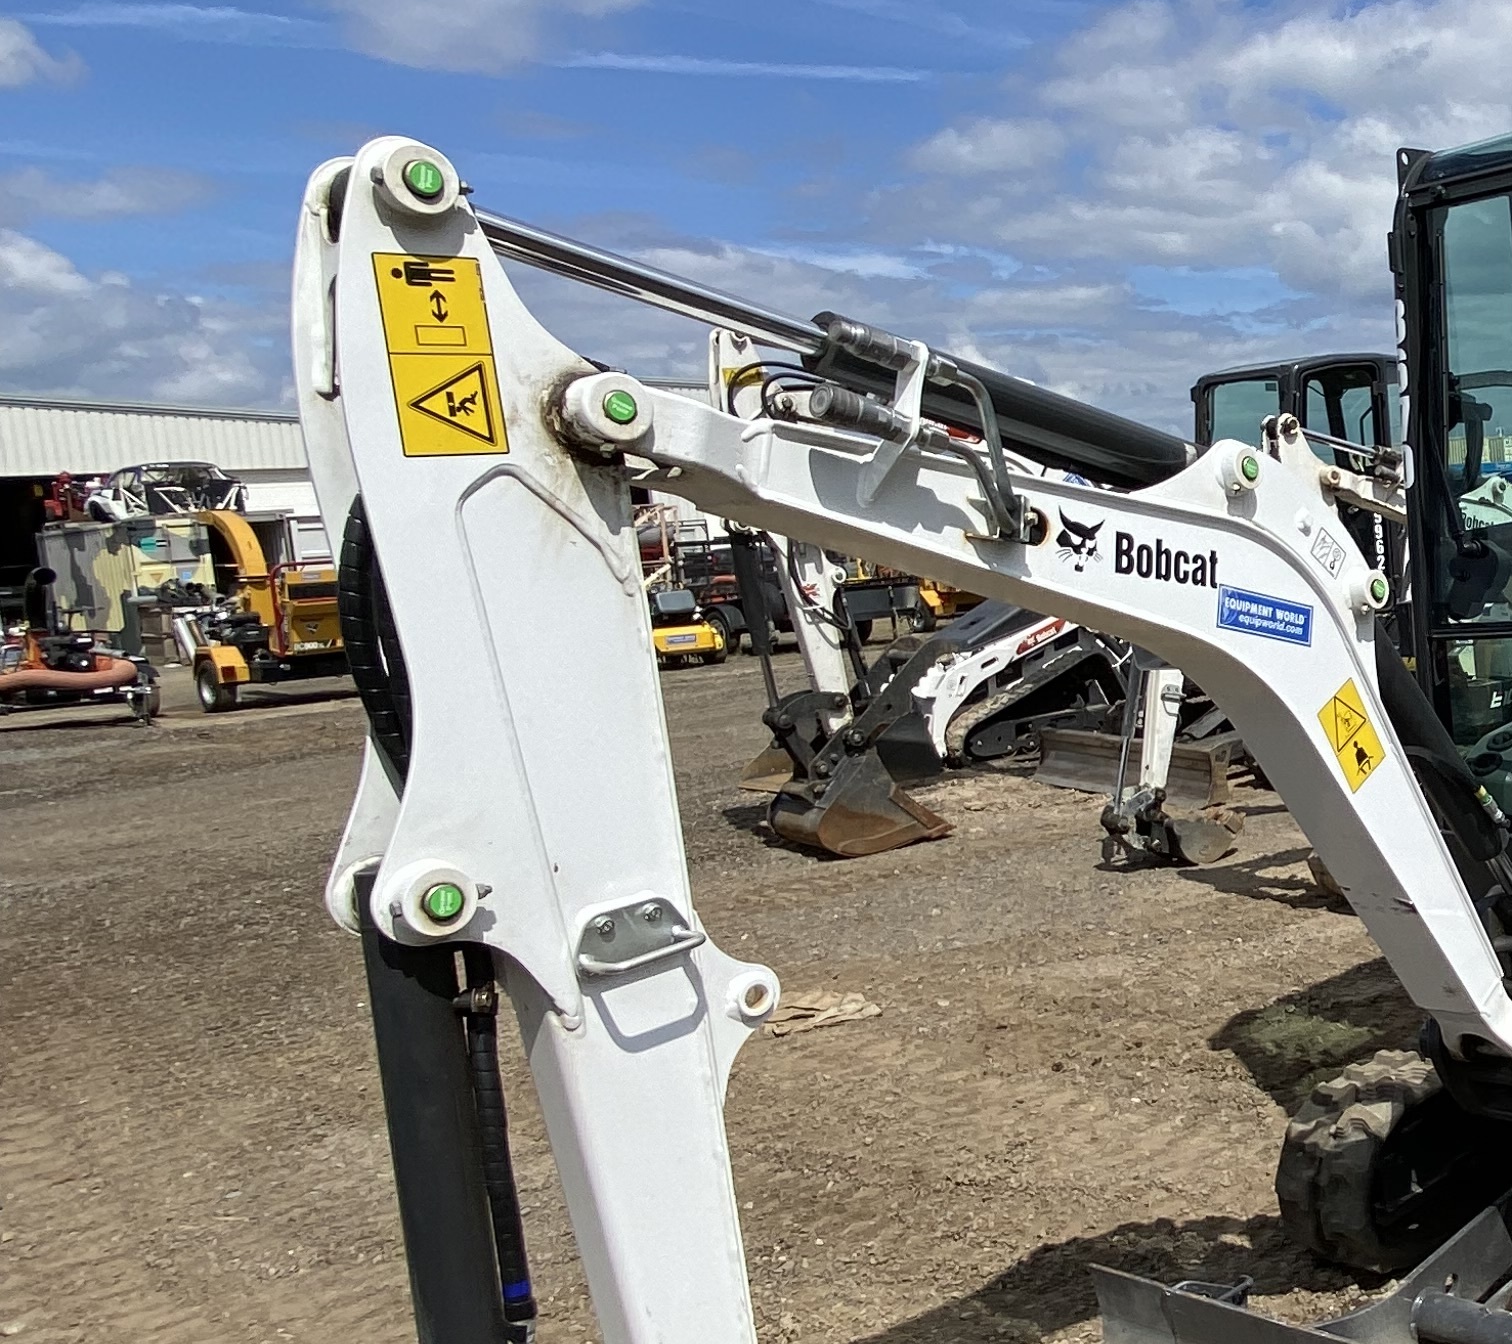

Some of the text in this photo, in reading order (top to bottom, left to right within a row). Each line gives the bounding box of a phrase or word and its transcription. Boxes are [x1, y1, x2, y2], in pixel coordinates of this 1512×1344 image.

[1115, 530, 1218, 588] Bobcat
[1224, 597, 1305, 625] EQUIPMENT WORLD
[1238, 614, 1303, 635] equipworld.com
